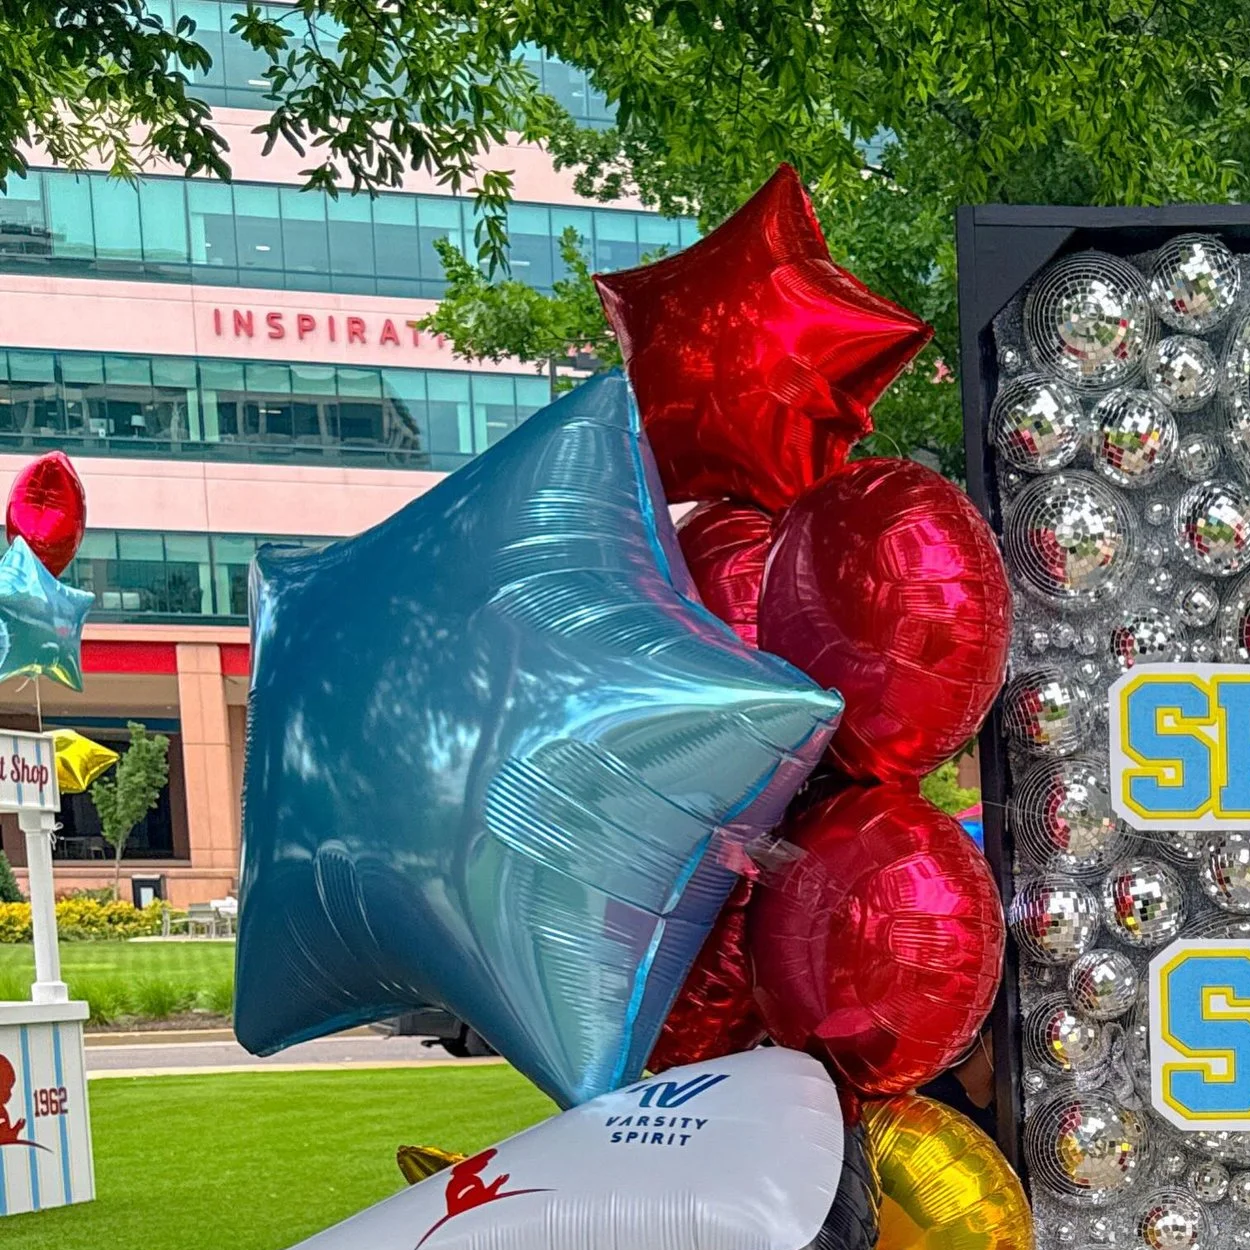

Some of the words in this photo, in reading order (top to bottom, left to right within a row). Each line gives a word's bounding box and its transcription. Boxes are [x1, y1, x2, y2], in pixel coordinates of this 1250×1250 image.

[11, 754, 48, 792] Shop
[34, 1087, 68, 1117] 1962
[605, 1115, 708, 1130] VARSITY
[610, 1131, 691, 1146] SPIRIT
